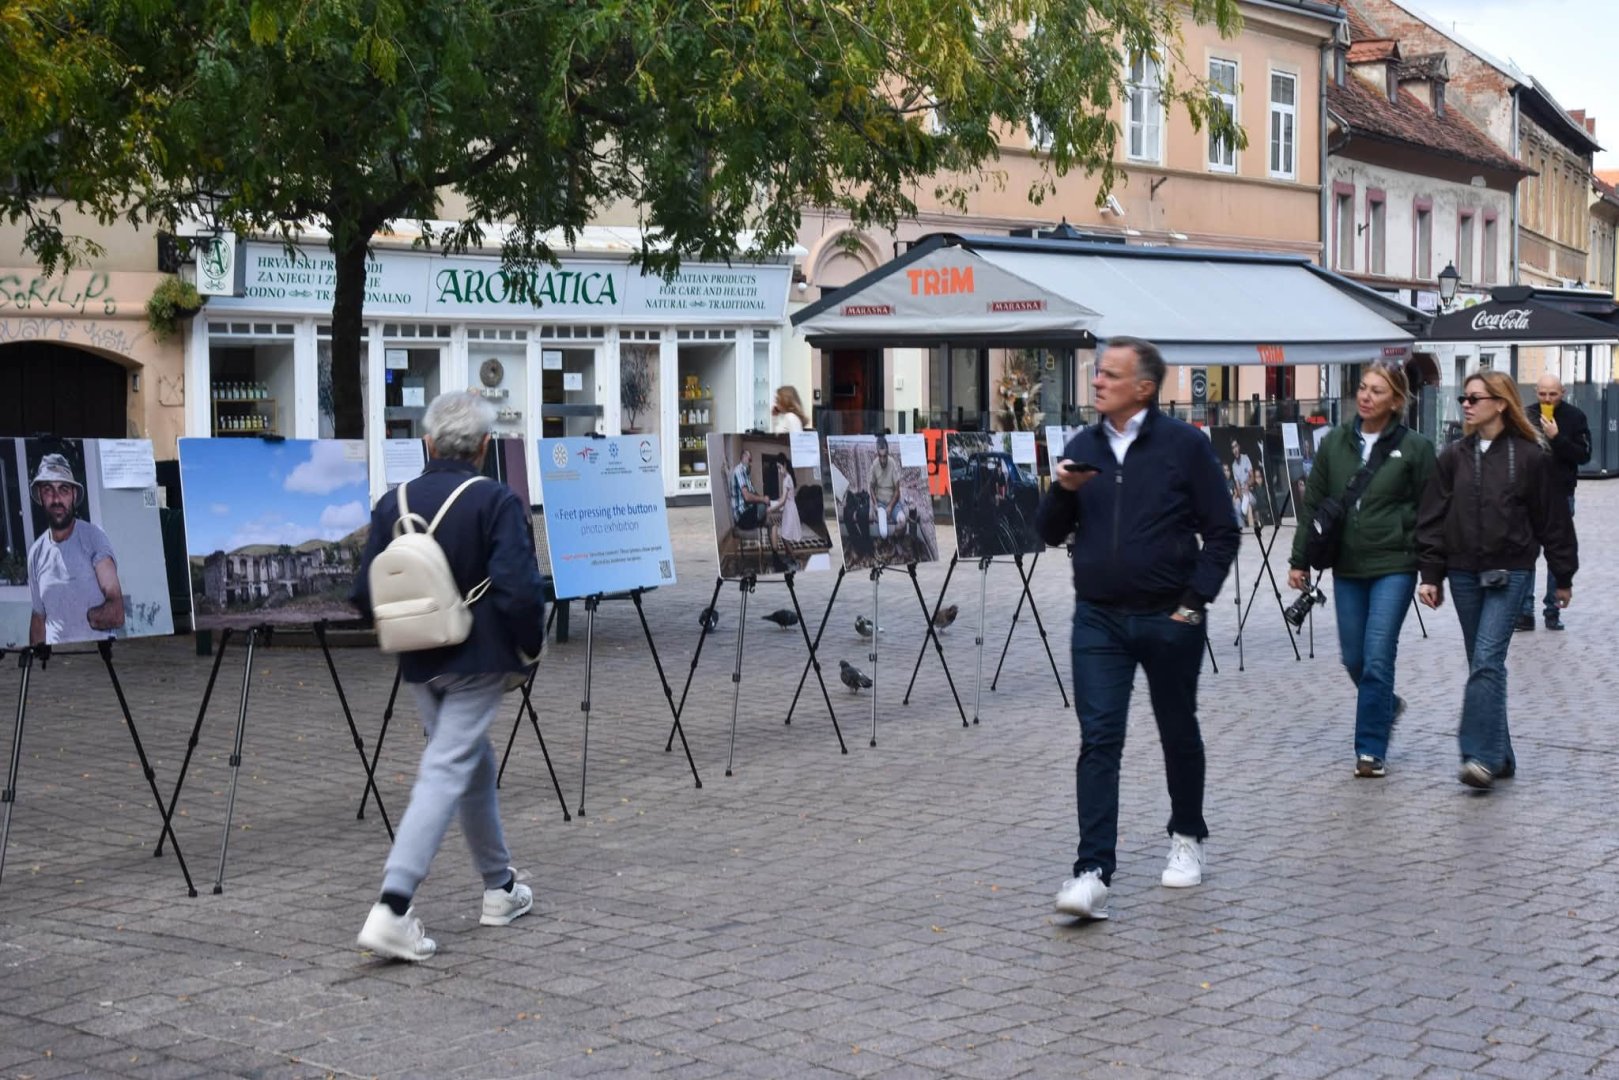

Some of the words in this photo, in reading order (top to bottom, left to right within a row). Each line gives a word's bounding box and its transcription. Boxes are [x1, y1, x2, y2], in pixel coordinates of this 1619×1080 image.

[258, 272, 273, 283] ZA
[278, 272, 315, 285] NJEGU
[318, 274, 322, 285] I
[711, 273, 756, 285] PRODUCTS
[436, 268, 618, 305] AROMATICA
[660, 285, 676, 295] FOR
[679, 286, 701, 296] CARE
[703, 286, 722, 297] AND
[724, 286, 757, 297] HEALTH
[645, 298, 687, 309] NATURAL
[709, 299, 766, 310] TRADITIONAL
[994, 301, 1038, 312] MARASKA
[580, 505, 612, 521] pressing
[613, 504, 626, 516] the
[581, 524, 603, 537] photo
[604, 520, 640, 533] exhibition
